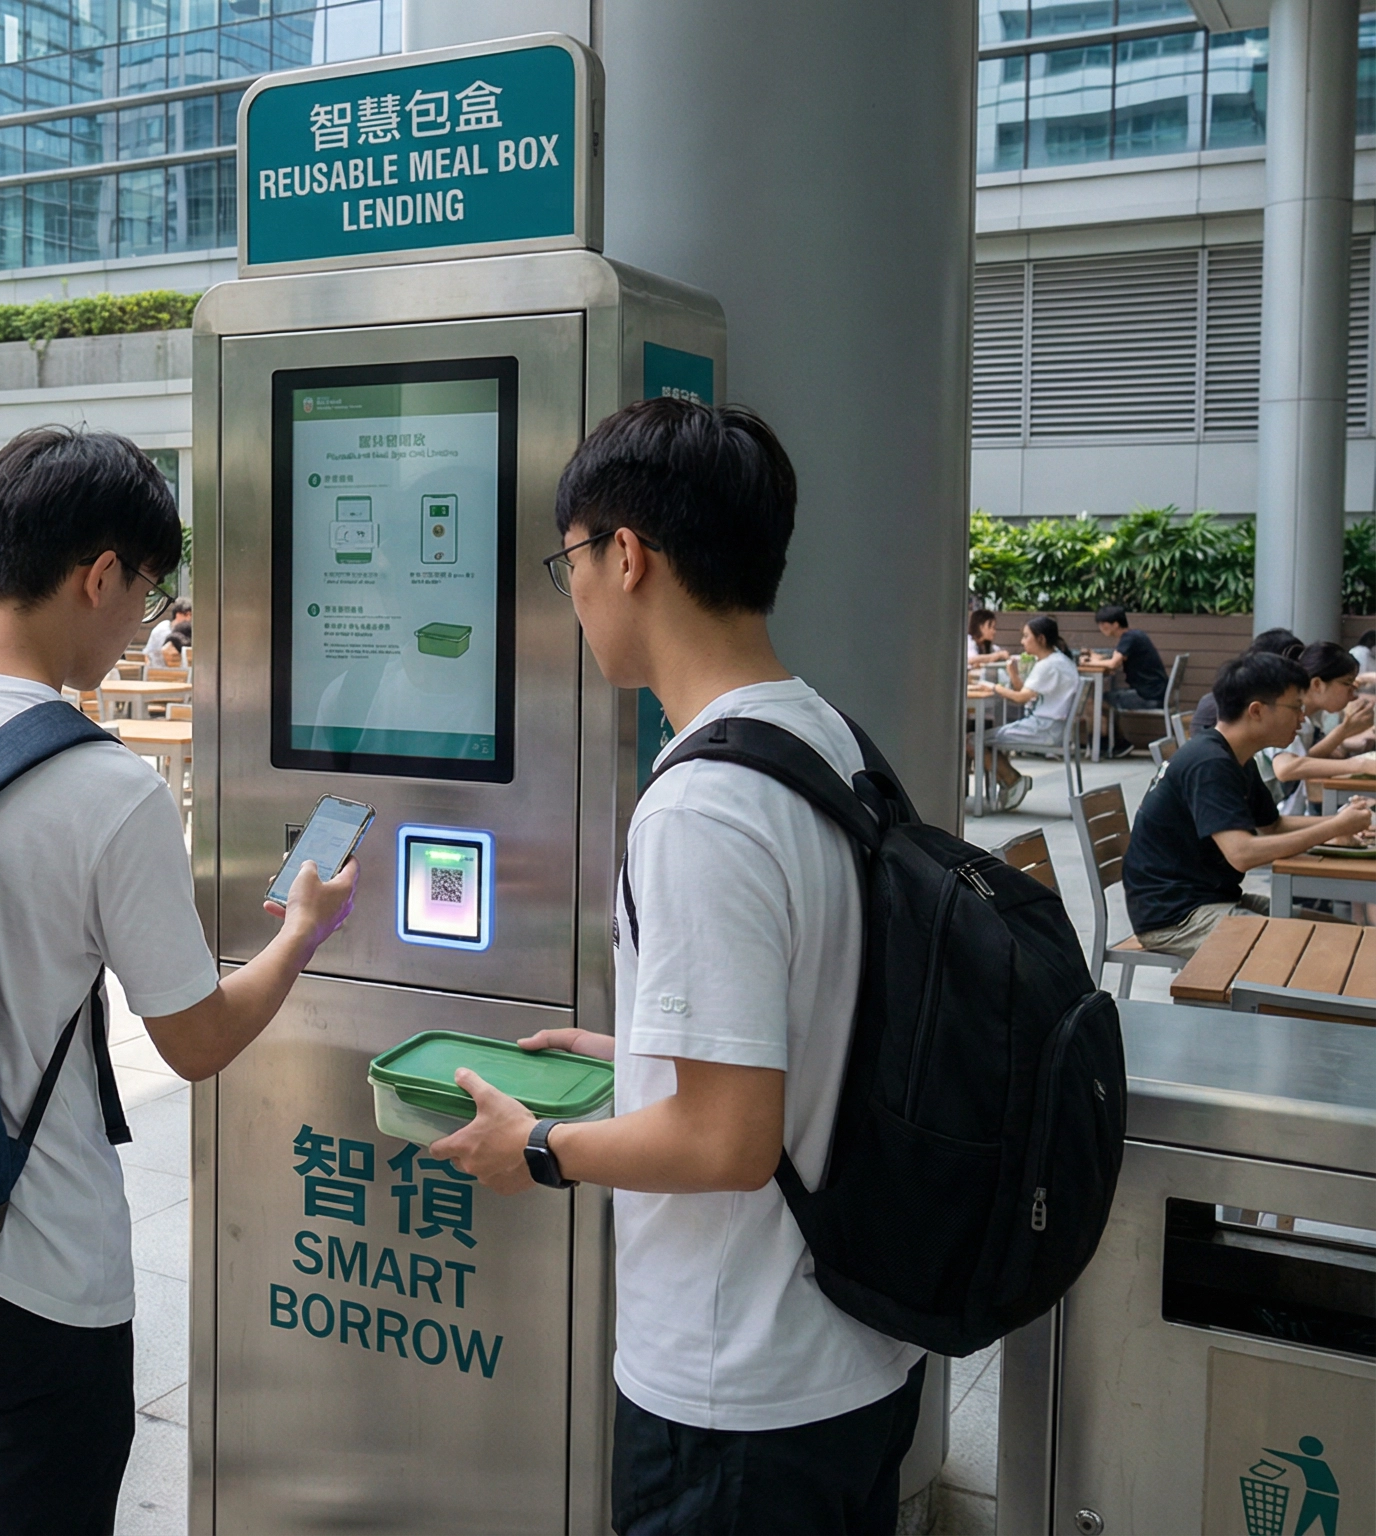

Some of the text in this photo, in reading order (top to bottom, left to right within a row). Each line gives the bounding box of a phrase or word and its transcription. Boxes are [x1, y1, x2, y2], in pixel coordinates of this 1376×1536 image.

[309, 80, 503, 152] 智慧包盒
[259, 134, 559, 200] REUSABLE MEAL BOX
[343, 188, 464, 232] LENDING
[291, 1230, 476, 1309] SMART
[269, 1283, 504, 1379] BORROW
